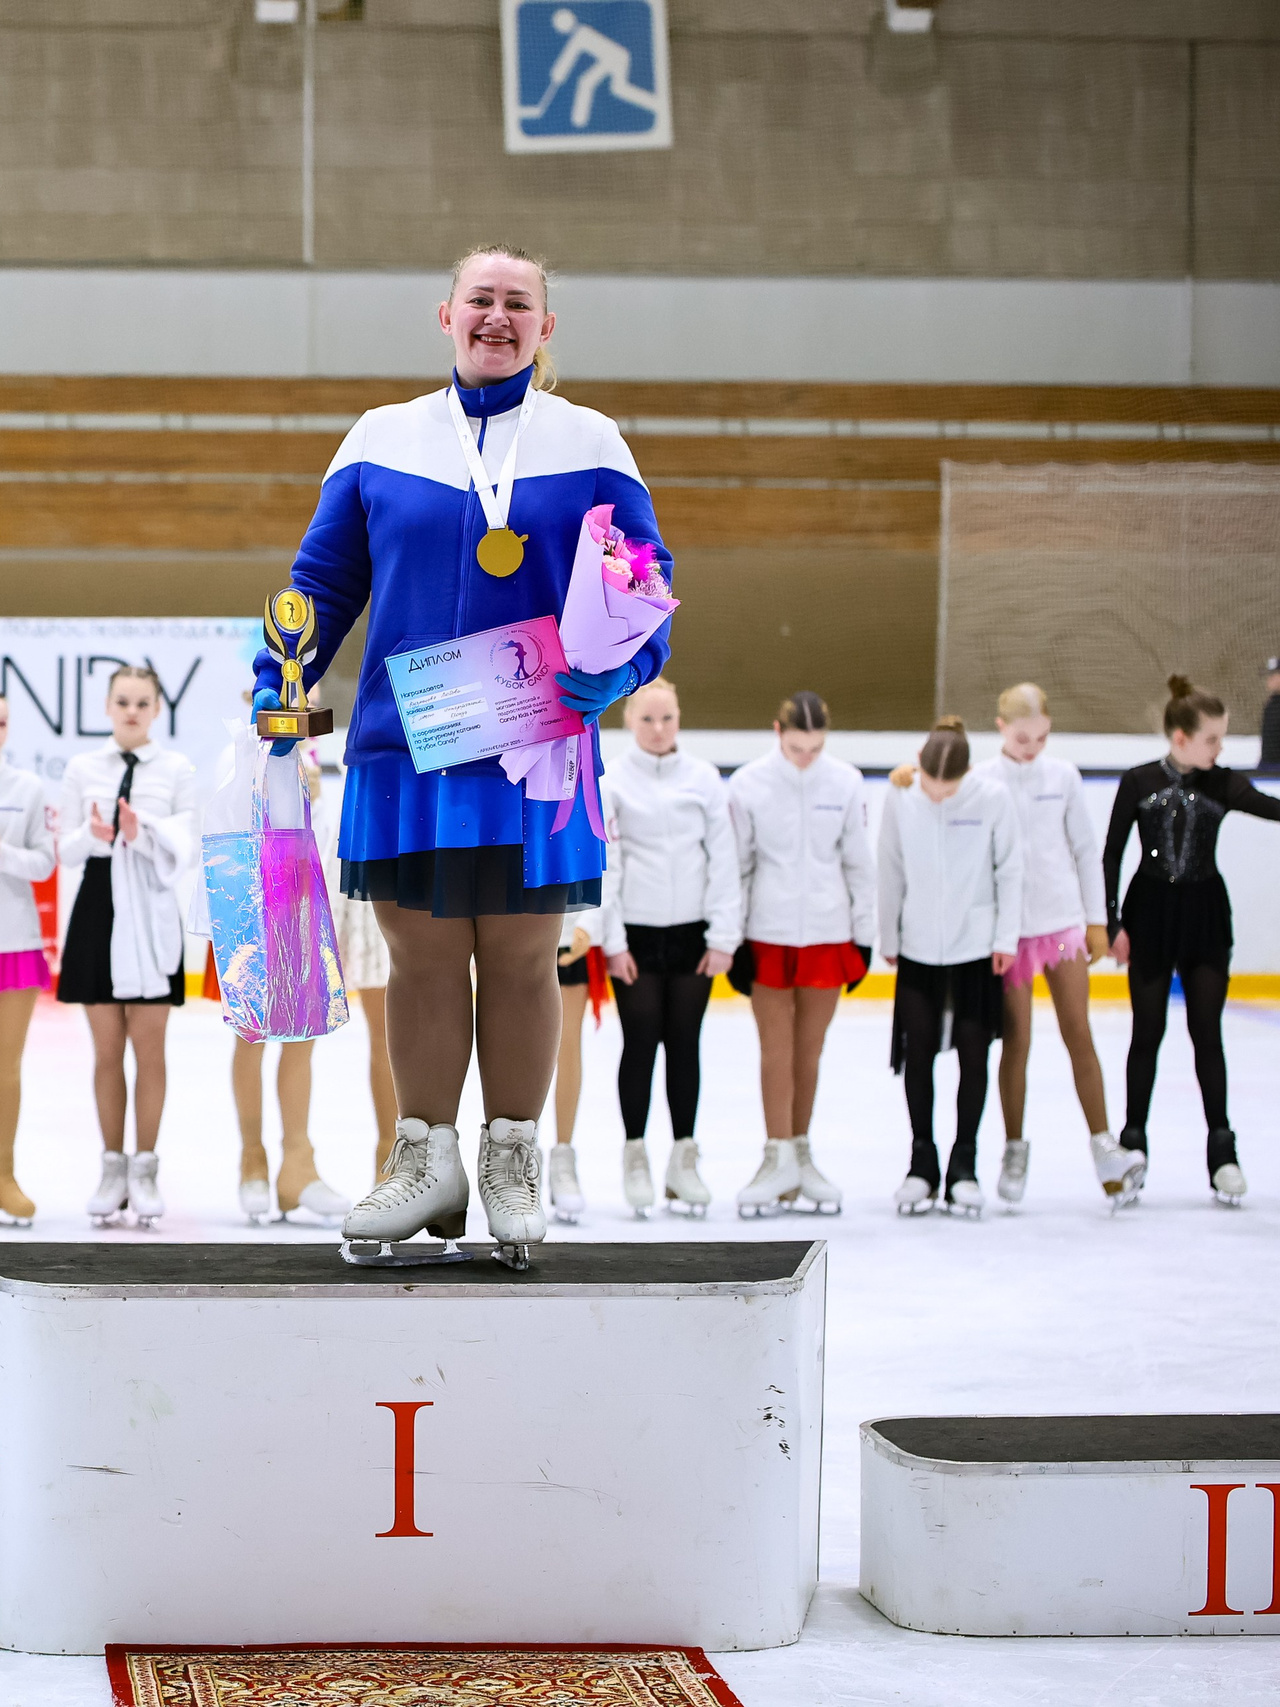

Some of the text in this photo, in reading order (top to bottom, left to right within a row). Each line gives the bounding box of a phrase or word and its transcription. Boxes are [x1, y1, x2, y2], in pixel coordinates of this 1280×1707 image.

[494, 662, 550, 690] КУБОК CANDY
[499, 714, 518, 724] Candy
[375, 1401, 434, 1538] I
